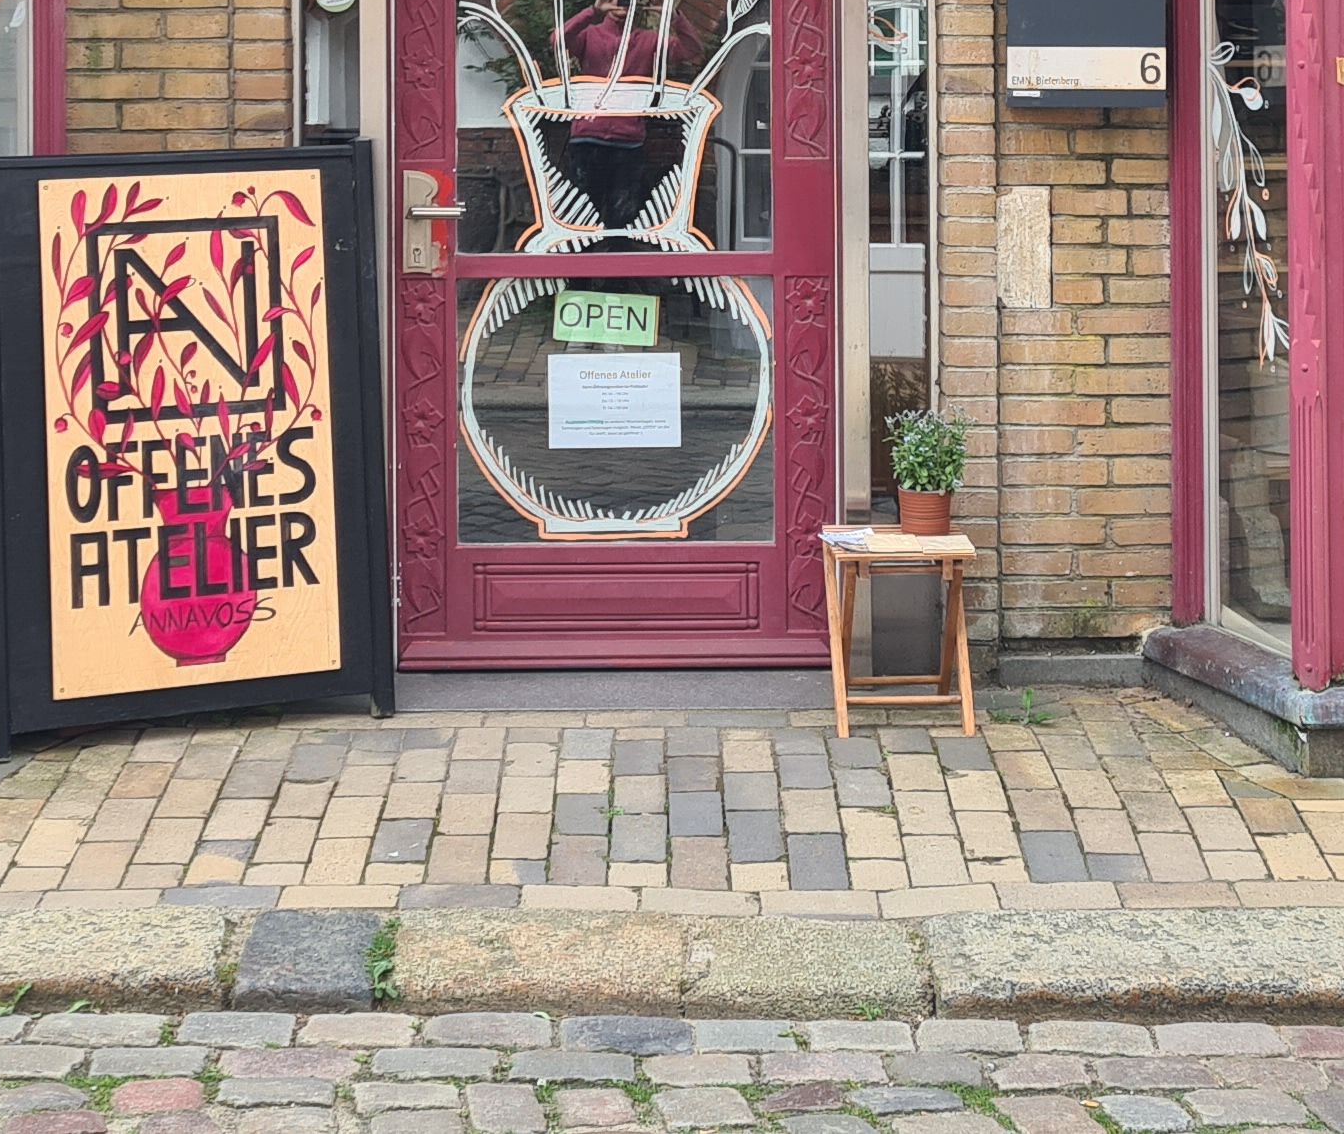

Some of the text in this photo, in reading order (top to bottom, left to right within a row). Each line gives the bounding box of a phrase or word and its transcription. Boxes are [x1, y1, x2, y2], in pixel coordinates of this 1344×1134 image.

[1140, 52, 1161, 85] 6
[559, 301, 648, 332] OPEN
[579, 369, 652, 380] Offenes Atelier
[65, 426, 317, 523] OFFENES
[70, 511, 320, 609] ATELIER
